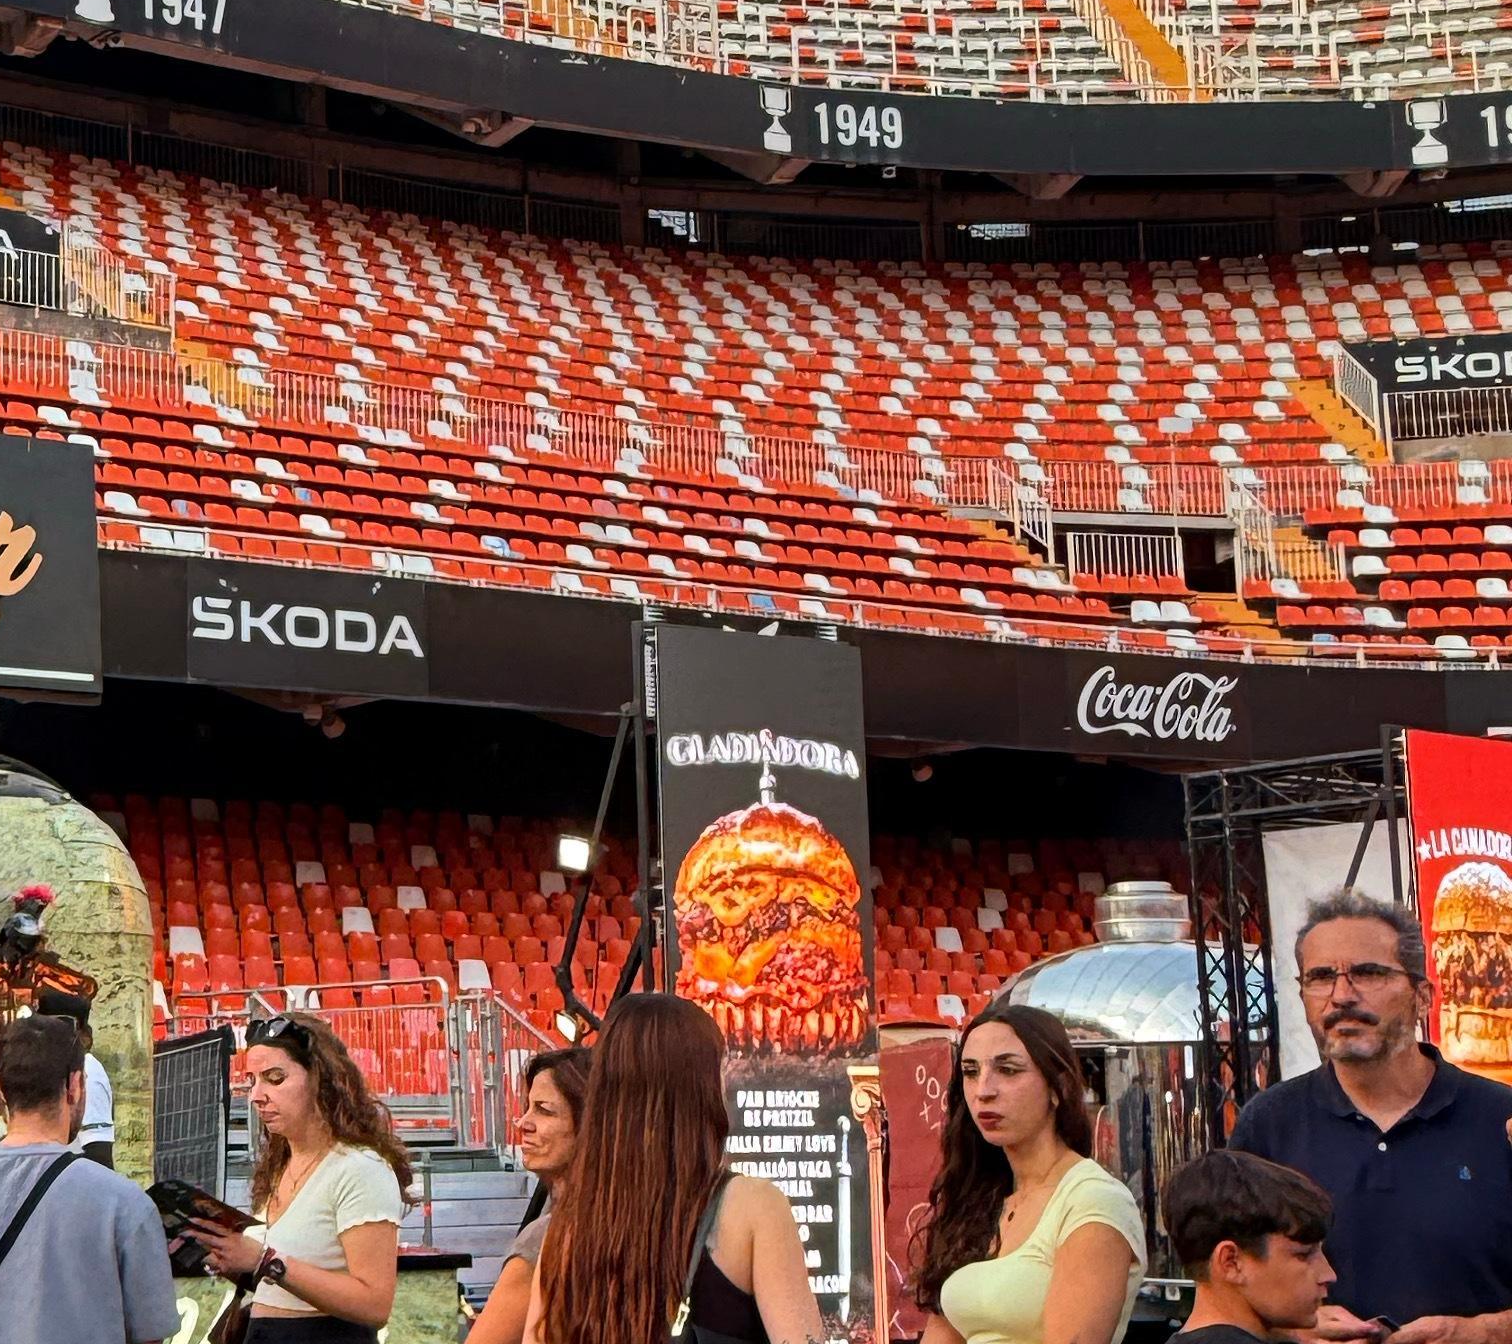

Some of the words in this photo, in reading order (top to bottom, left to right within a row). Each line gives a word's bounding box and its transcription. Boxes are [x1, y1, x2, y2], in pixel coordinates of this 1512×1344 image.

[814, 102, 903, 149] 1949
[1077, 665, 1238, 742] Coca-Cola
[1430, 828, 1452, 859] LA
